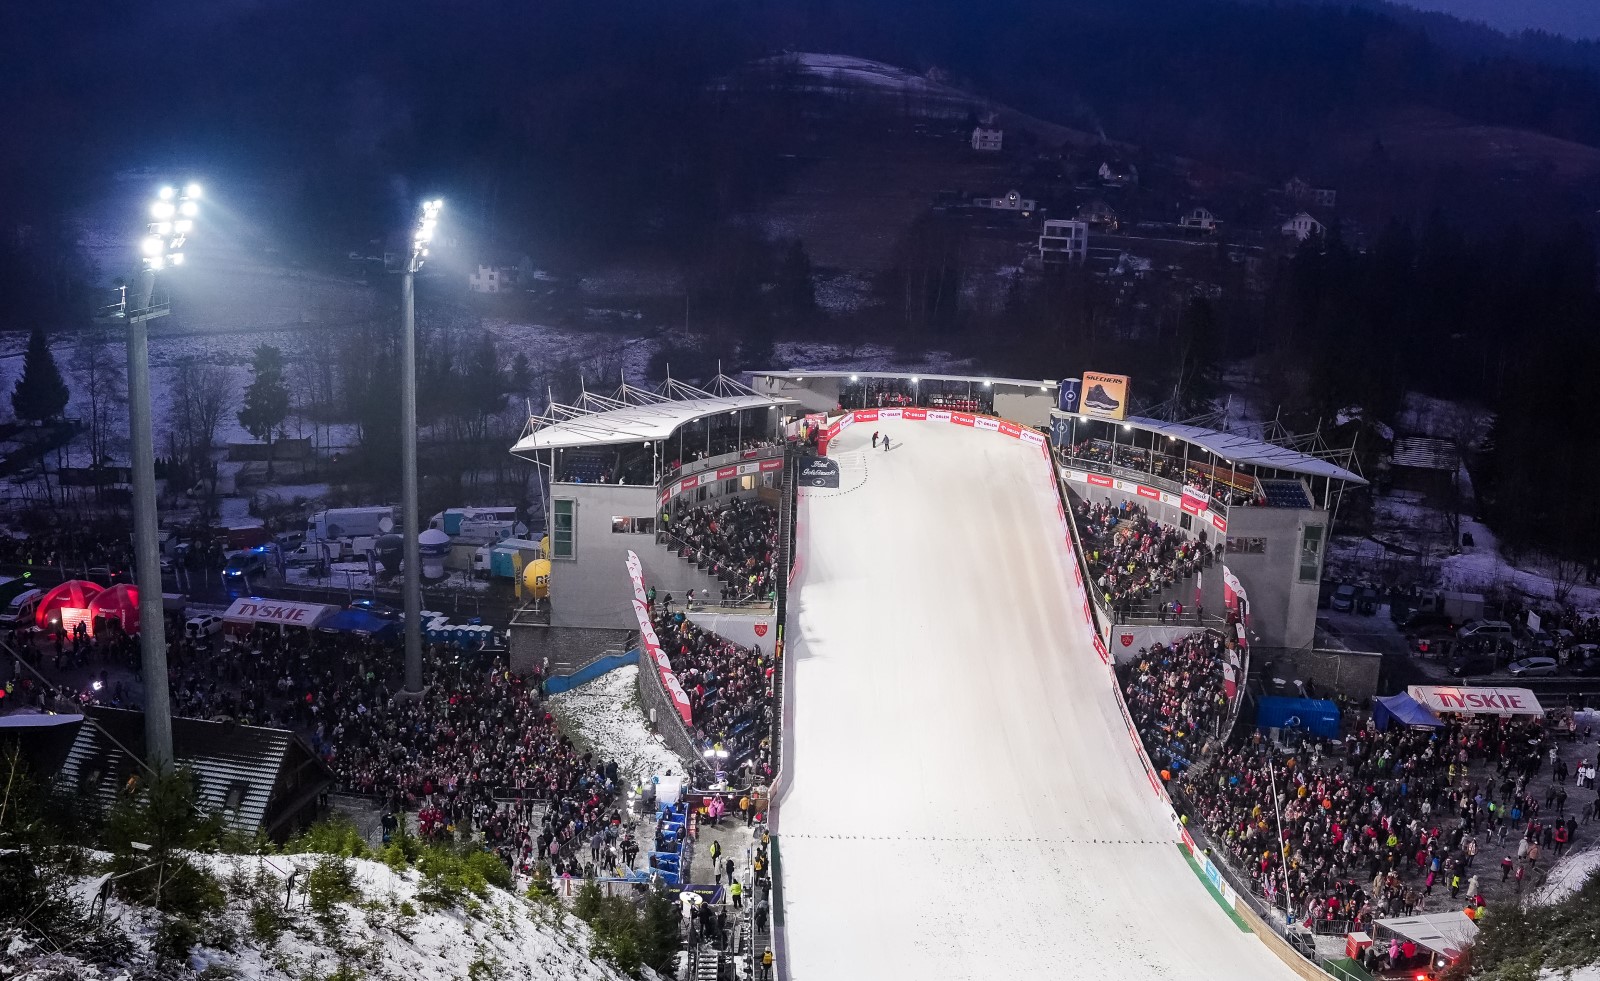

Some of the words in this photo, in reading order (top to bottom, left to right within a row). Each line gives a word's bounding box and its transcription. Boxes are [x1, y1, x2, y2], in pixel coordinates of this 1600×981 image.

[1086, 374, 1123, 385] SKECHERS
[237, 603, 310, 621] TYSKIE
[1433, 692, 1527, 709] TYSKIE
